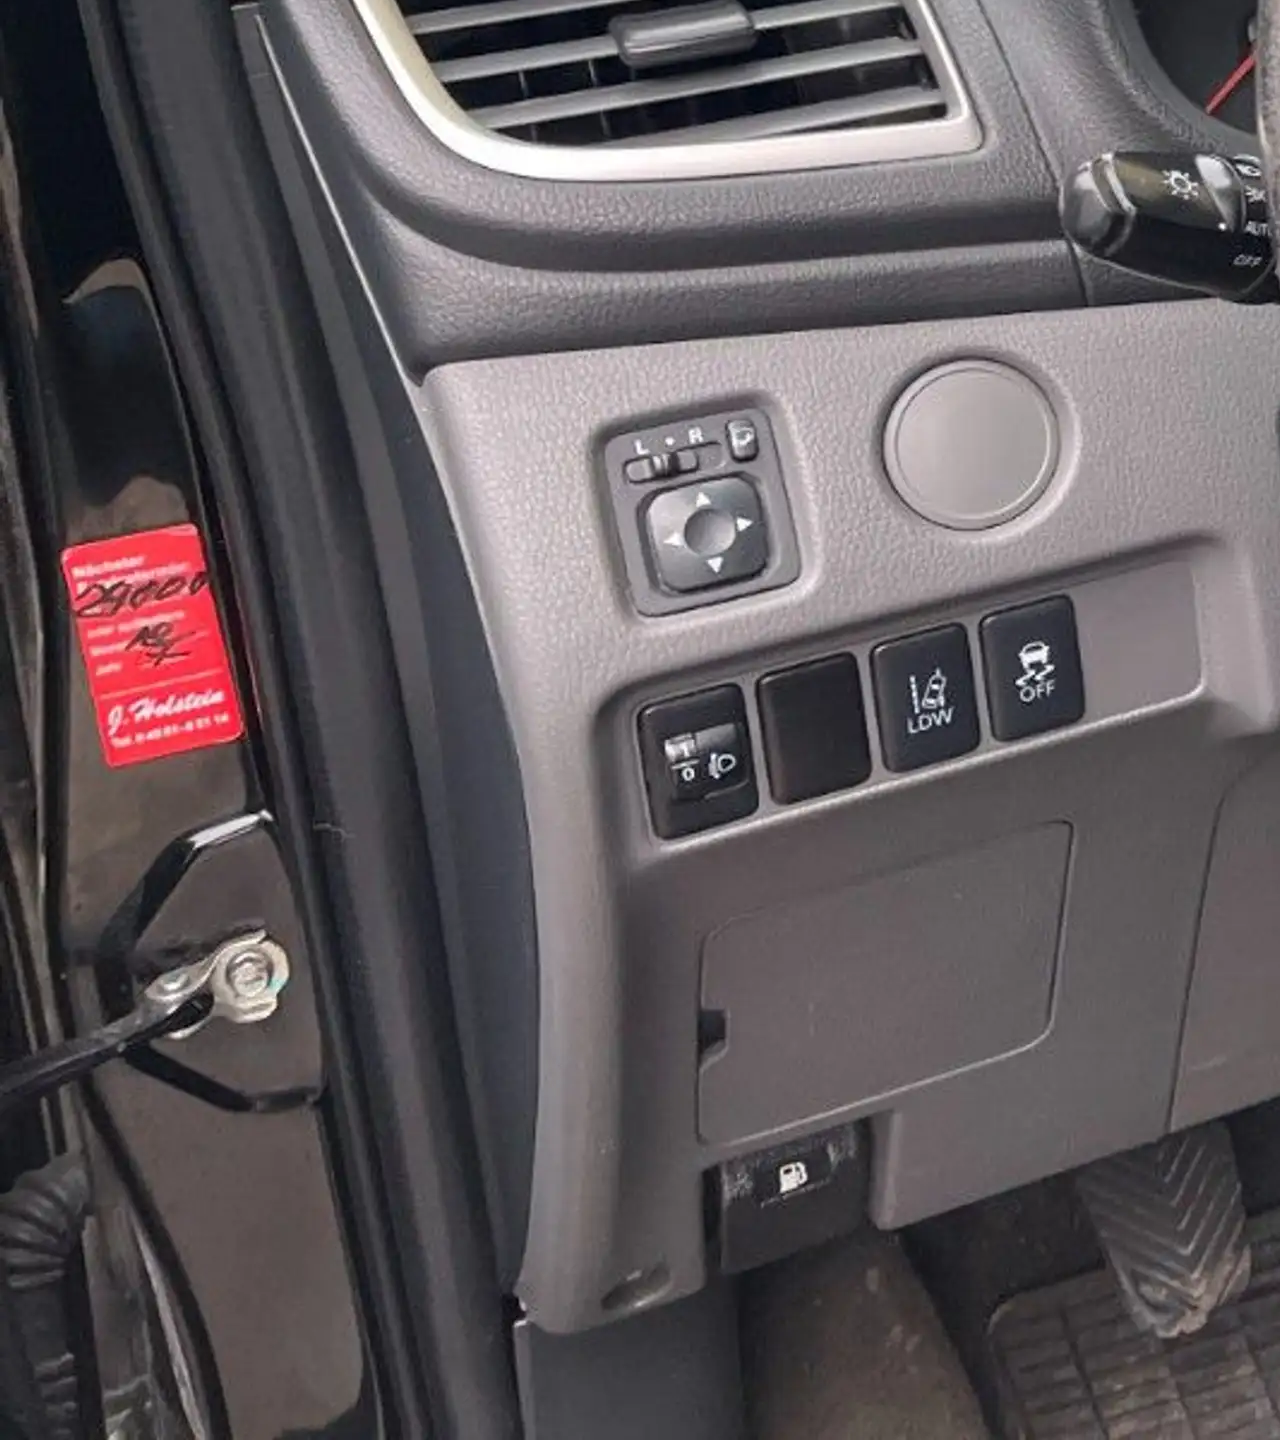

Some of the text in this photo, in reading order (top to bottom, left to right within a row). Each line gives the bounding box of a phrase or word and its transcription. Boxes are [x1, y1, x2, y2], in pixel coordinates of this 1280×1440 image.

[634, 426, 704, 455] L R
[1019, 679, 1056, 702] OFF
